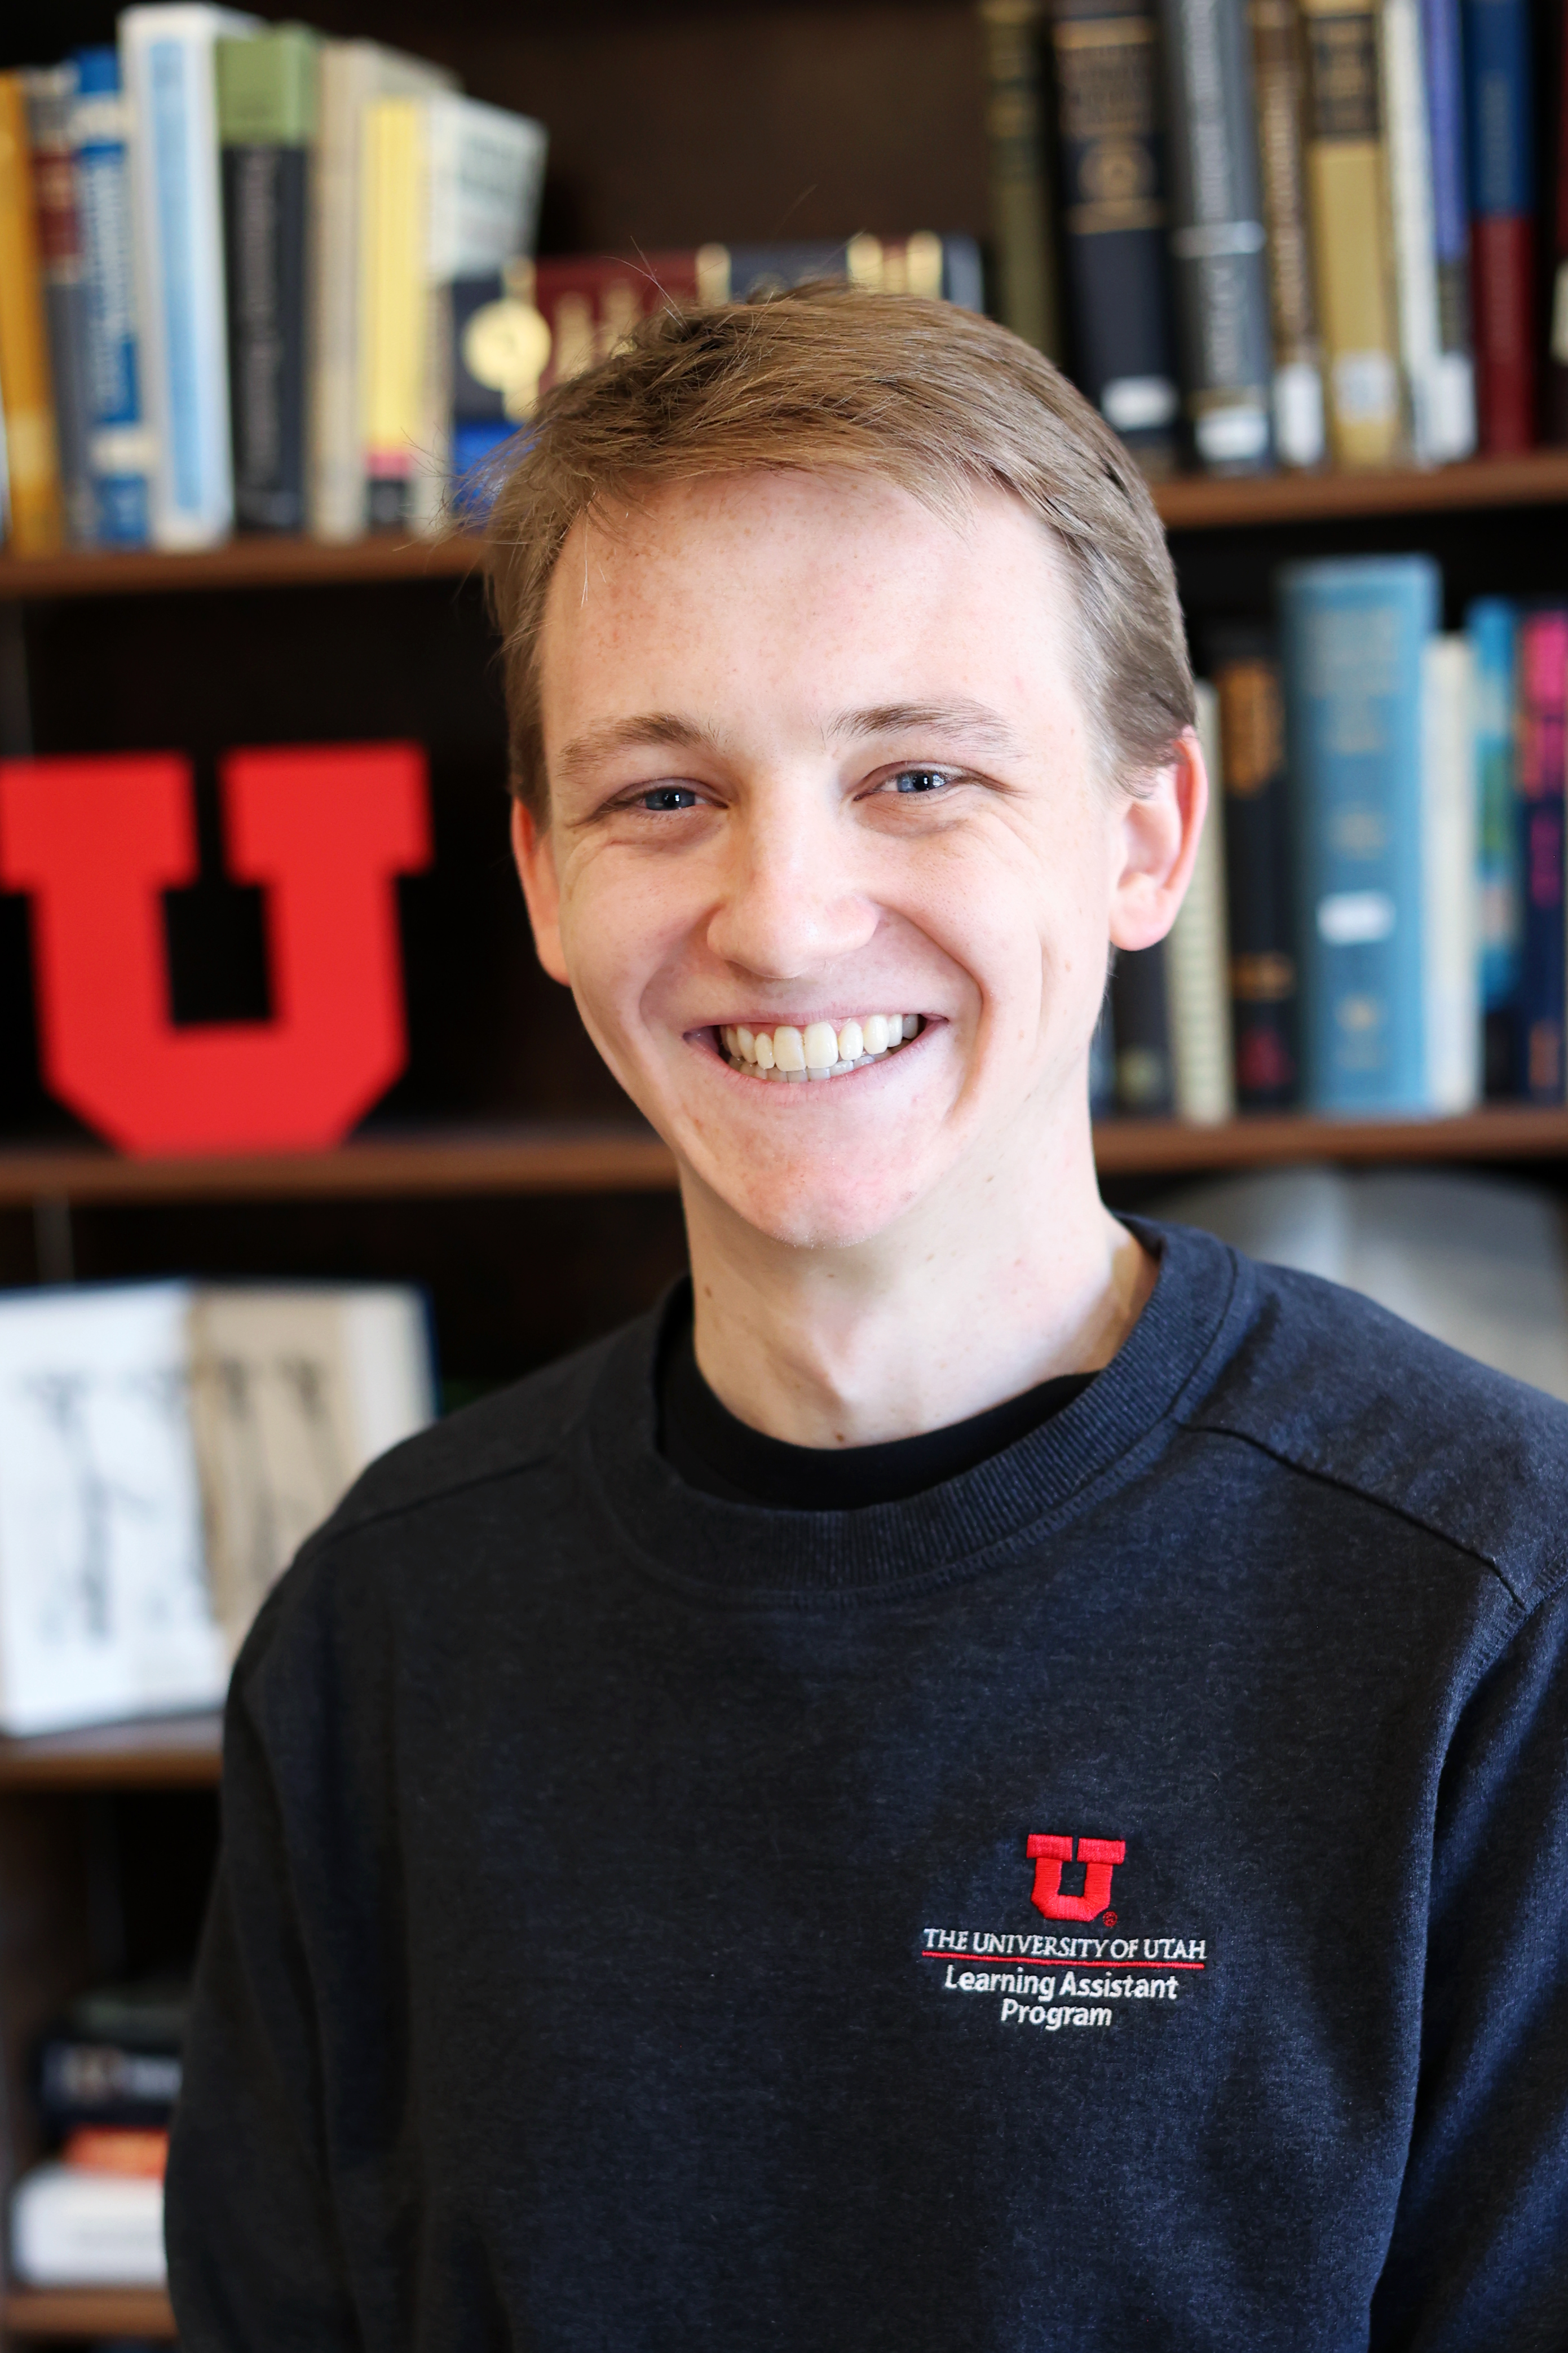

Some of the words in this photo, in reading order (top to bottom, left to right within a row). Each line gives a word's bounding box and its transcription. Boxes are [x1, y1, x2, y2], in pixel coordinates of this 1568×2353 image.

[0, 742, 435, 1160] U
[1027, 1834, 1126, 1922] U
[923, 1928, 968, 1950] THE
[973, 1932, 1110, 1958] UNIVERSITY
[1111, 1939, 1138, 1959] OF
[1143, 1938, 1207, 1959] UTAH
[945, 1964, 1055, 2001] Learning
[1059, 1971, 1179, 1999] Assistant
[1000, 1998, 1112, 2030] Program
